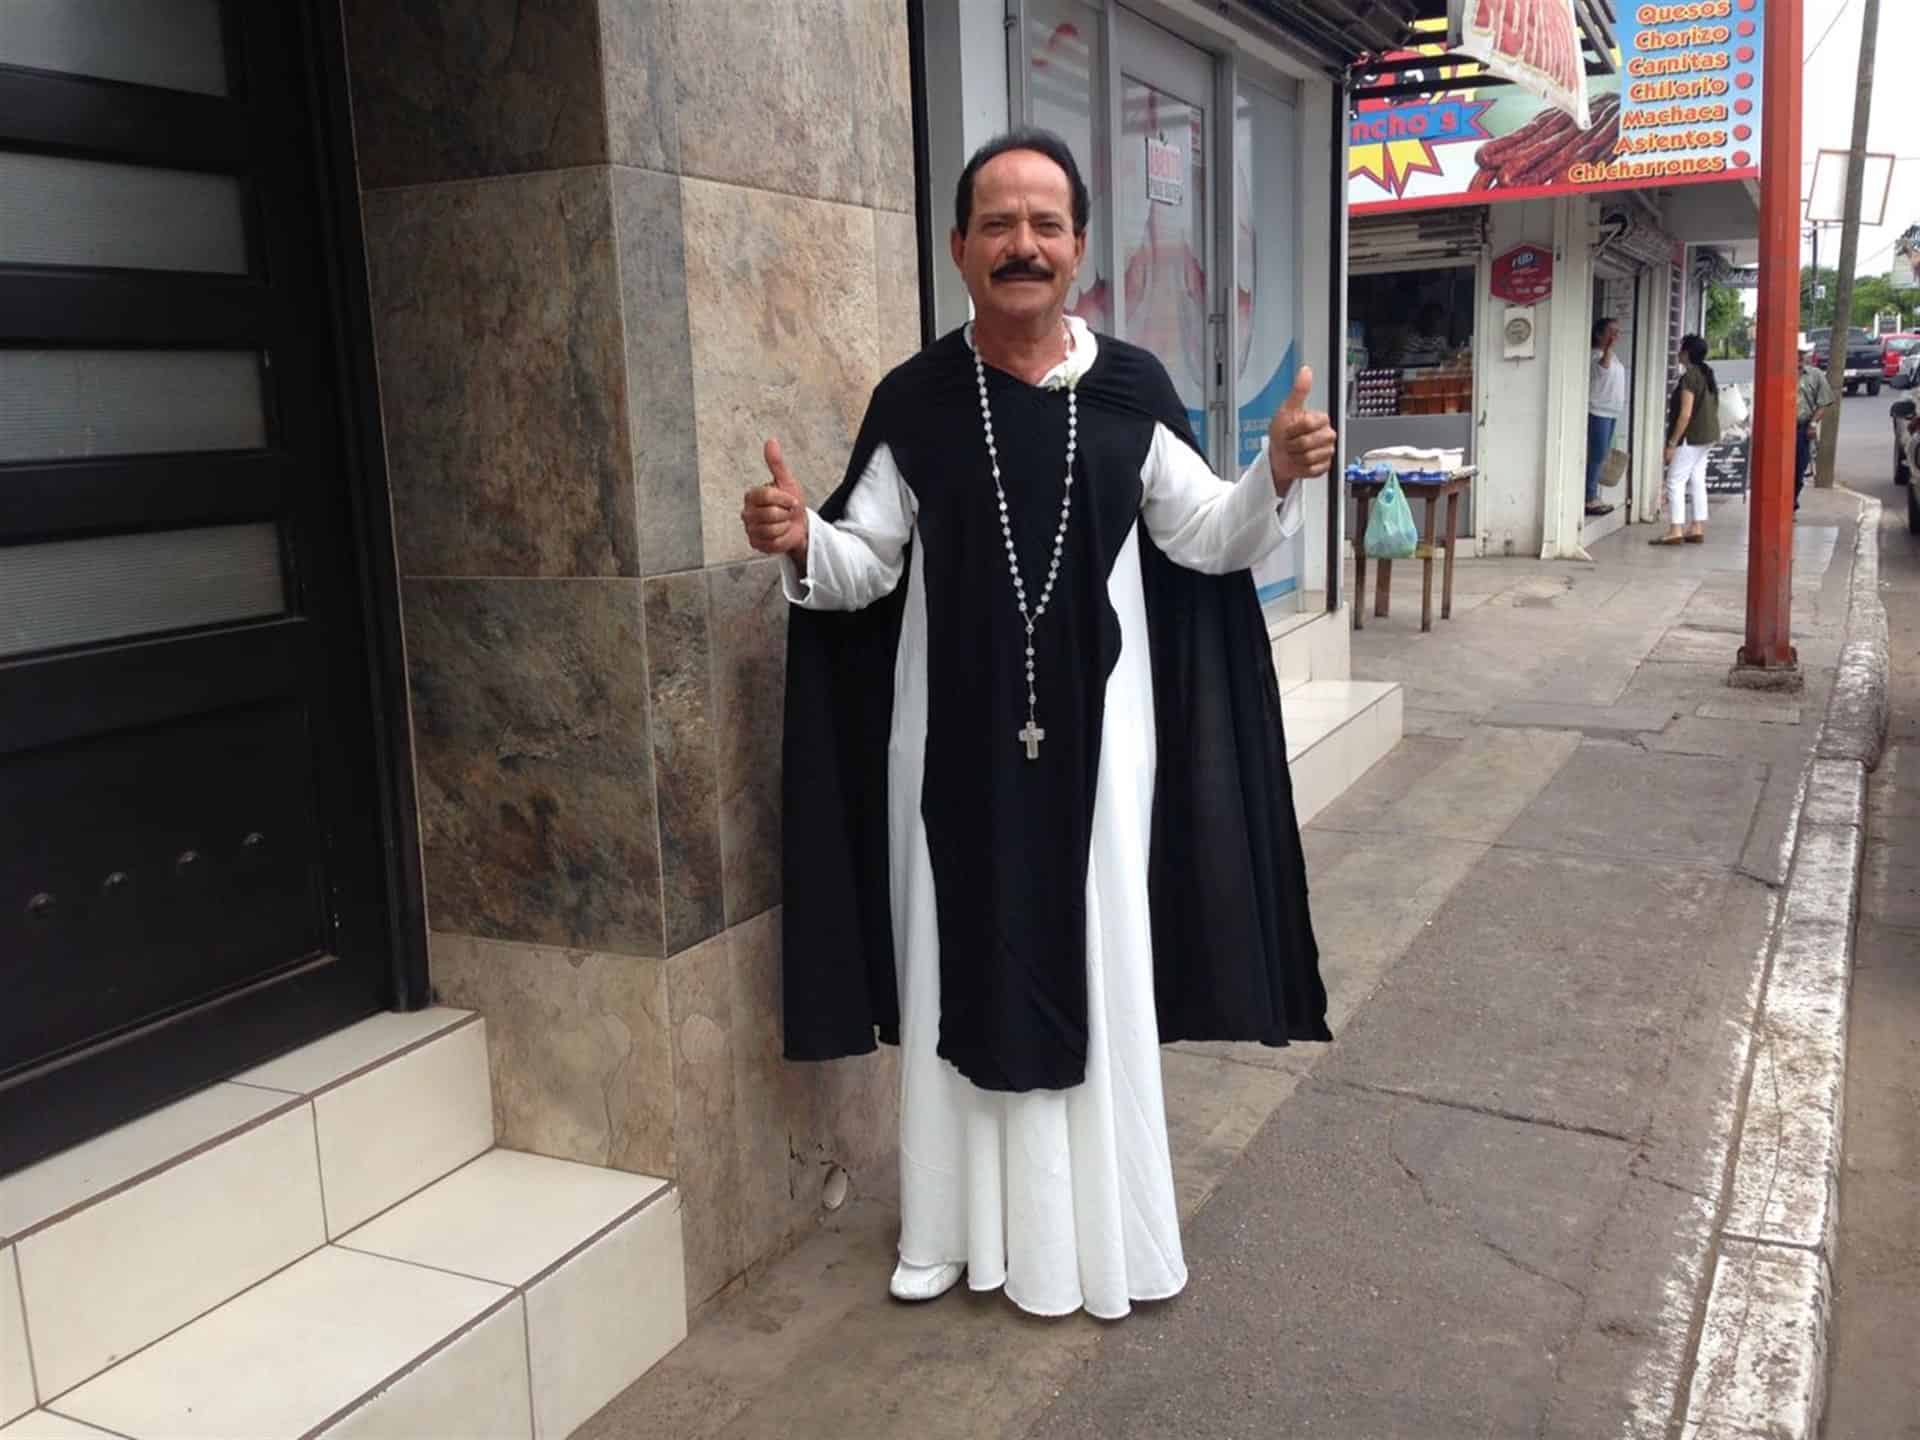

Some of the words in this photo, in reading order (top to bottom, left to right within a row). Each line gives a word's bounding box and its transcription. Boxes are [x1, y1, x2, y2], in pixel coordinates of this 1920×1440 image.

[1636, 1, 1731, 23] Quesos
[1635, 25, 1730, 49] Chorizo
[1628, 52, 1729, 76] Carnitas
[1629, 77, 1728, 102] Chilorio
[1351, 104, 1457, 142] ncho's
[1622, 104, 1727, 128] Machaca
[1613, 129, 1727, 155] Asientos
[1568, 155, 1725, 183] Chicharrones
